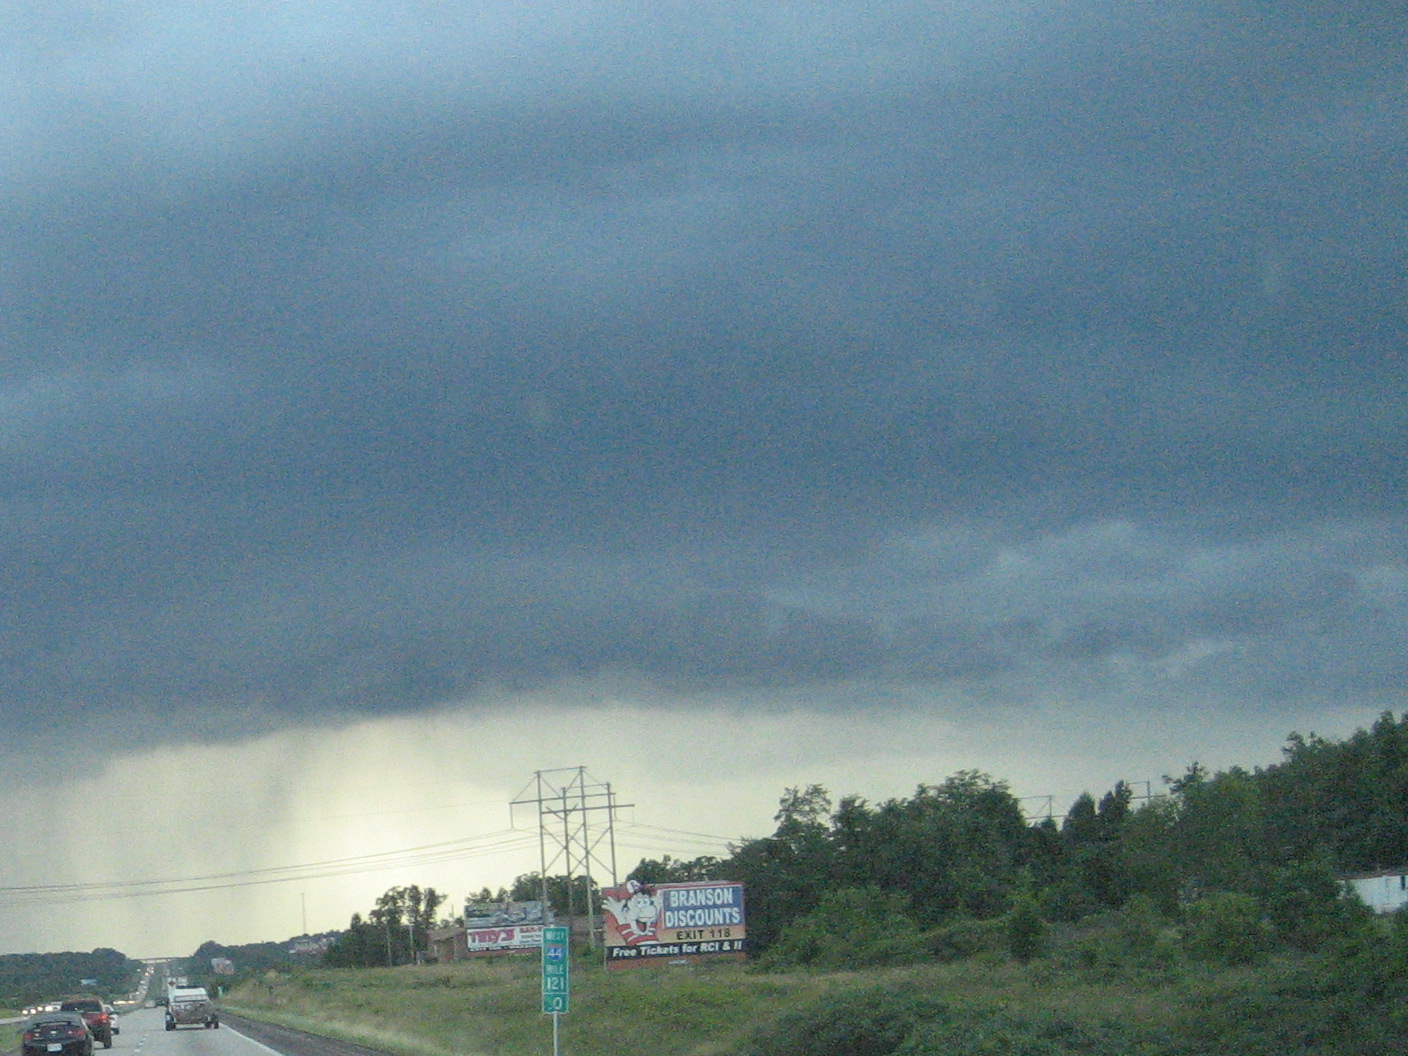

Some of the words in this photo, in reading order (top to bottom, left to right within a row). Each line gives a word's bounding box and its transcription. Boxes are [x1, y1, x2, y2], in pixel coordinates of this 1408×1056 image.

[669, 888, 732, 907] BRANSON
[665, 908, 740, 927] DISCOUNTS
[545, 931, 564, 941] WEST
[677, 930, 704, 940] EXIT
[711, 928, 730, 939] 118
[547, 947, 563, 958] 44
[613, 947, 637, 957] Free
[640, 945, 679, 956] Tickets
[682, 943, 698, 953] for
[700, 942, 719, 952] RCI
[722, 941, 731, 951] &
[545, 964, 564, 975] MILE
[547, 976, 564, 990] 121
